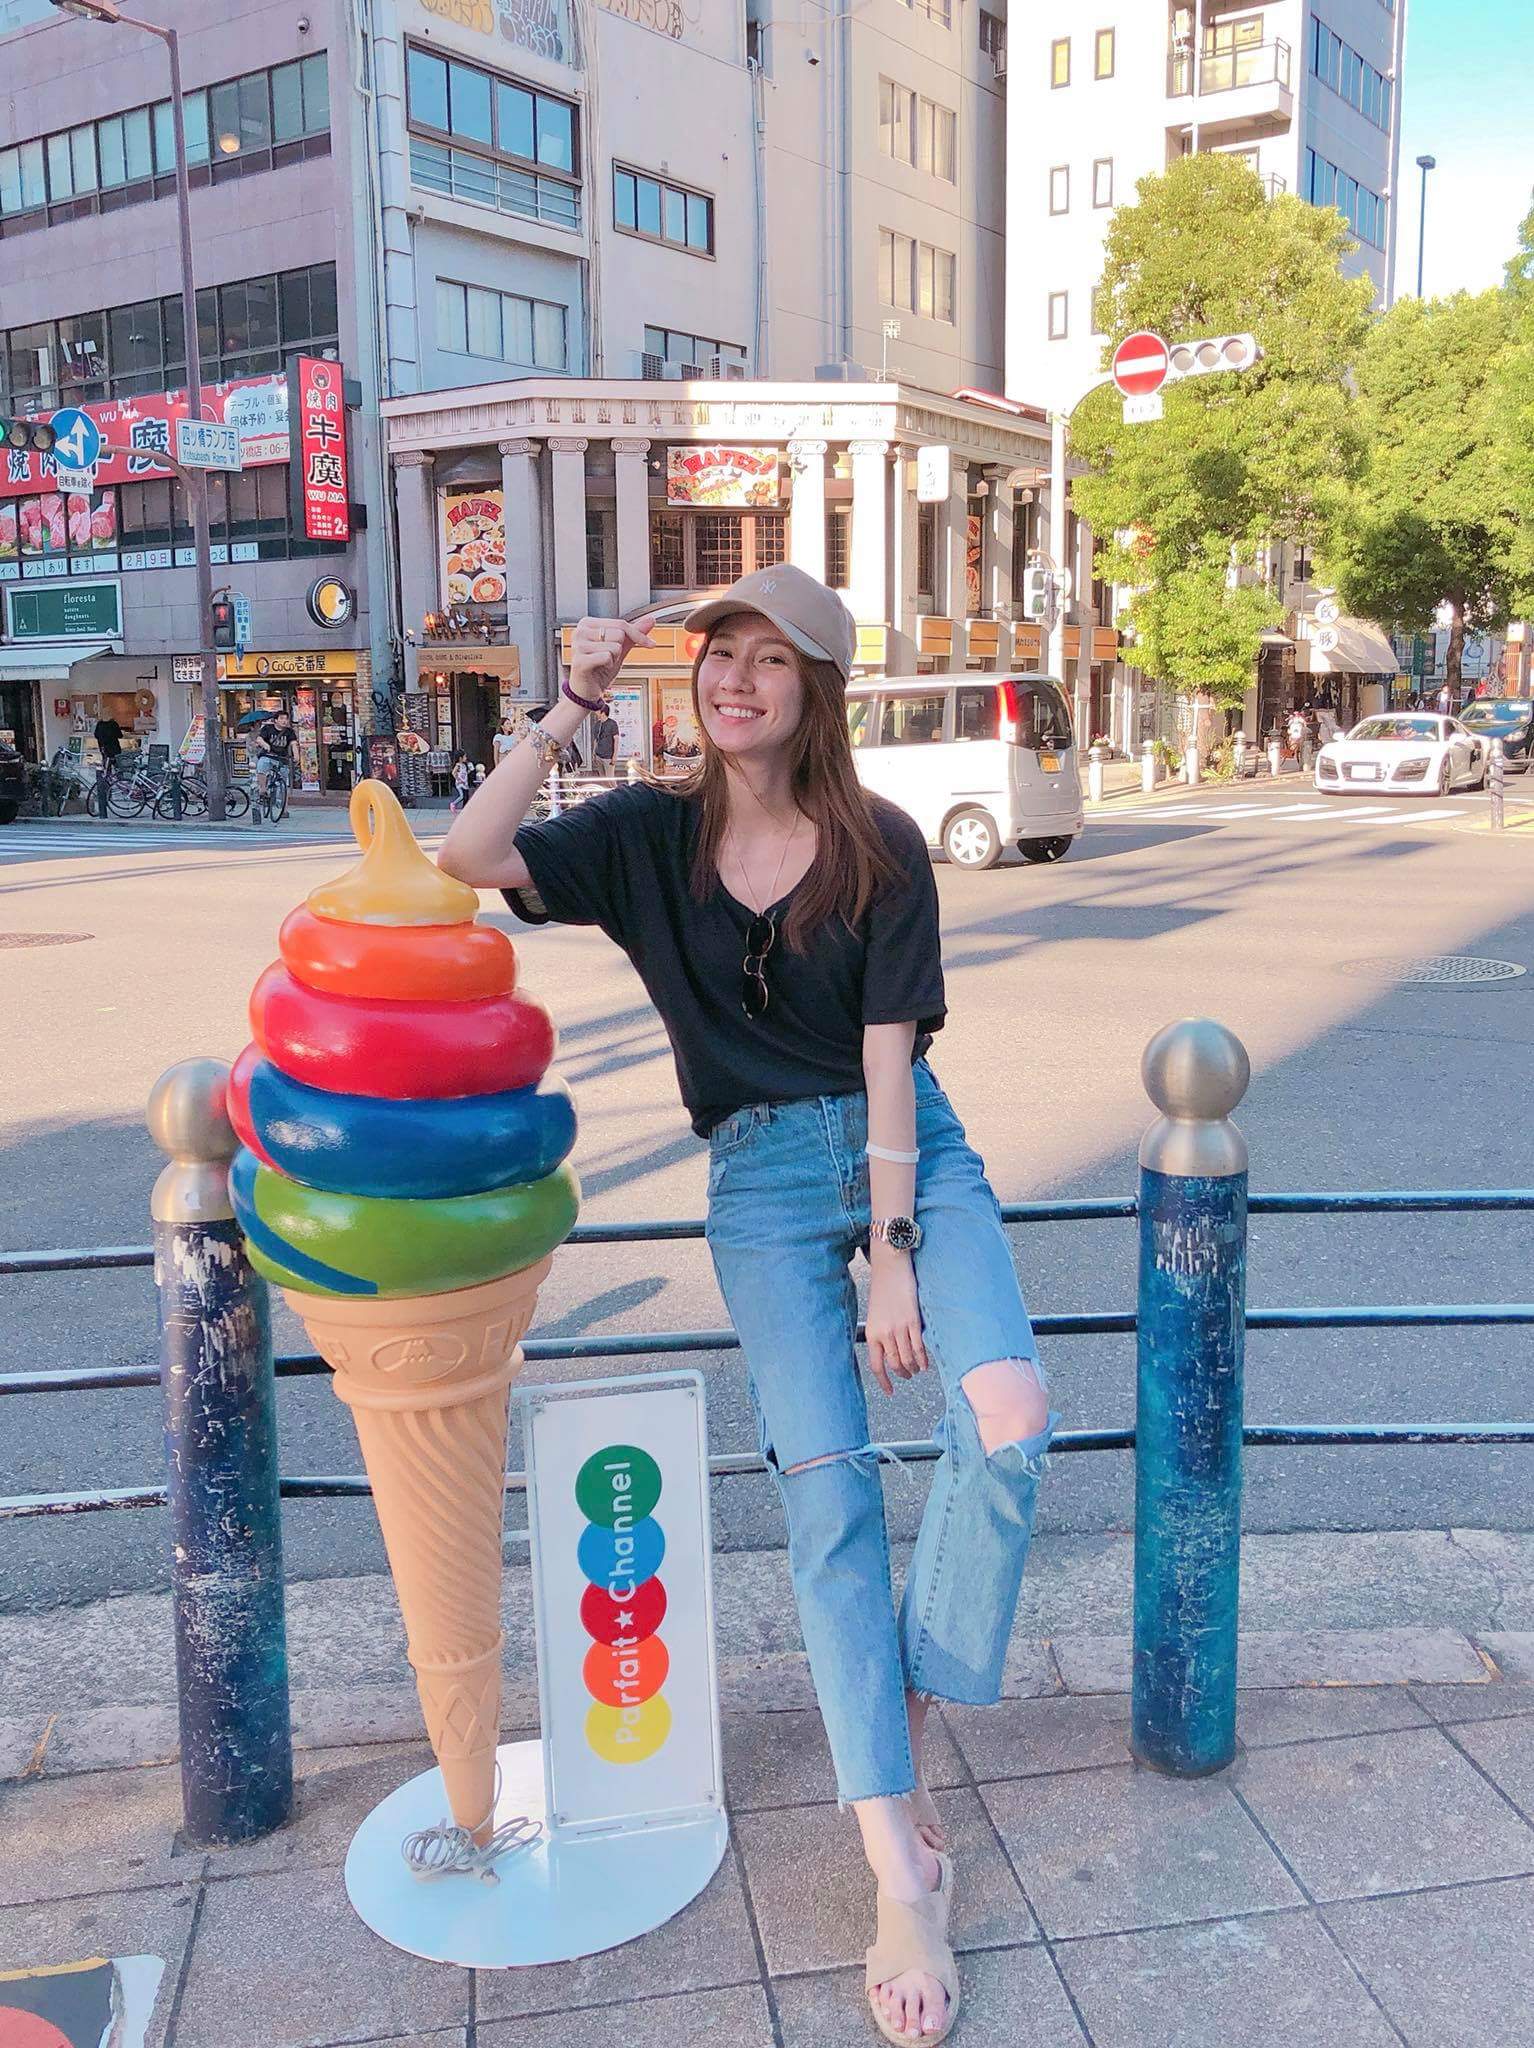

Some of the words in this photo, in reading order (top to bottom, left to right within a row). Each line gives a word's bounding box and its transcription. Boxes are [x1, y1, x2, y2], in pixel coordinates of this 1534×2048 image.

[100, 412, 117, 424] WU
[121, 407, 140, 420] MA
[681, 449, 763, 476] HAFEZ
[307, 489, 326, 502] WU
[327, 491, 346, 504] MA
[447, 499, 502, 527] HAFEZ
[334, 517, 348, 535] 2F
[63, 592, 96, 604] floresta
[603, 1461, 638, 1602] Channel
[611, 1636, 641, 1745] Parfait
